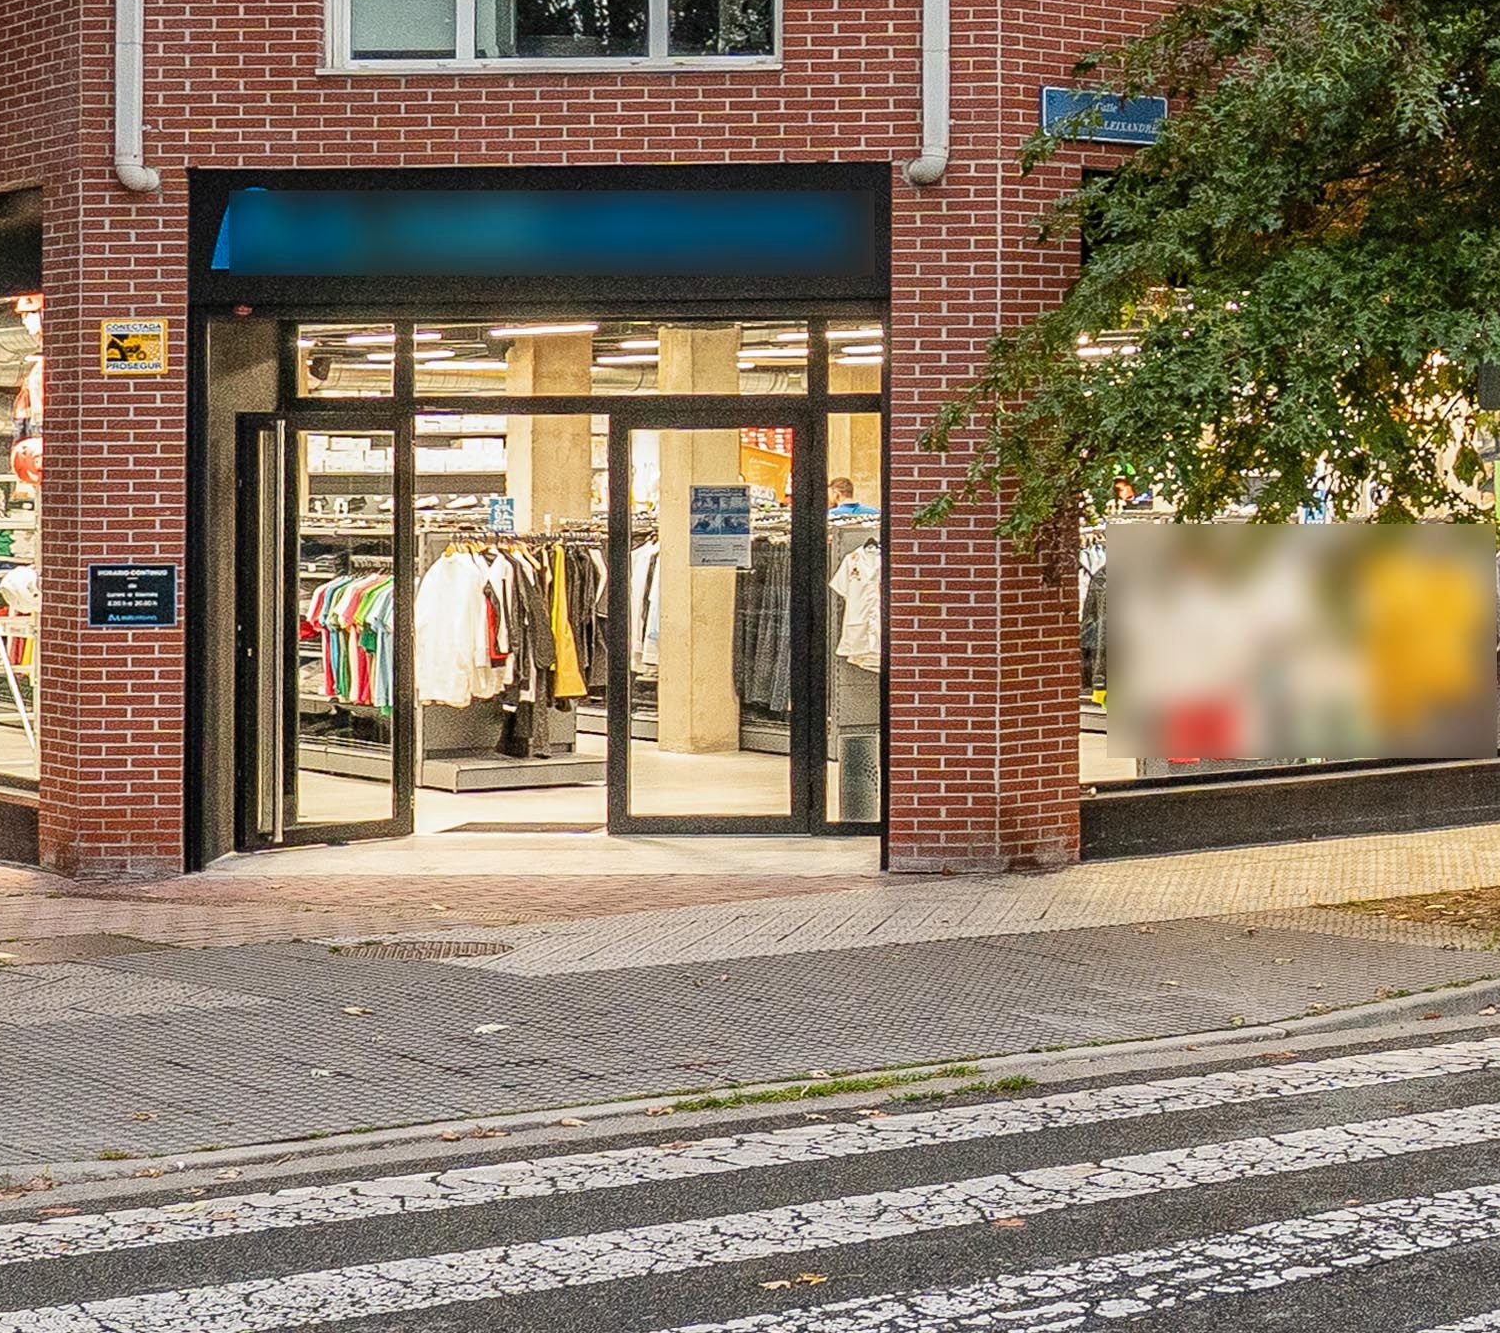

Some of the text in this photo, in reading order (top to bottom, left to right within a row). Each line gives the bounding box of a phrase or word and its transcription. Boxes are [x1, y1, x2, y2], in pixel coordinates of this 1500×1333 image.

[1095, 102, 1118, 113] Calle
[1096, 120, 1158, 134] LEIXANDRE
[105, 323, 161, 331] CONECTADA
[106, 362, 162, 370] PROSEGUR
